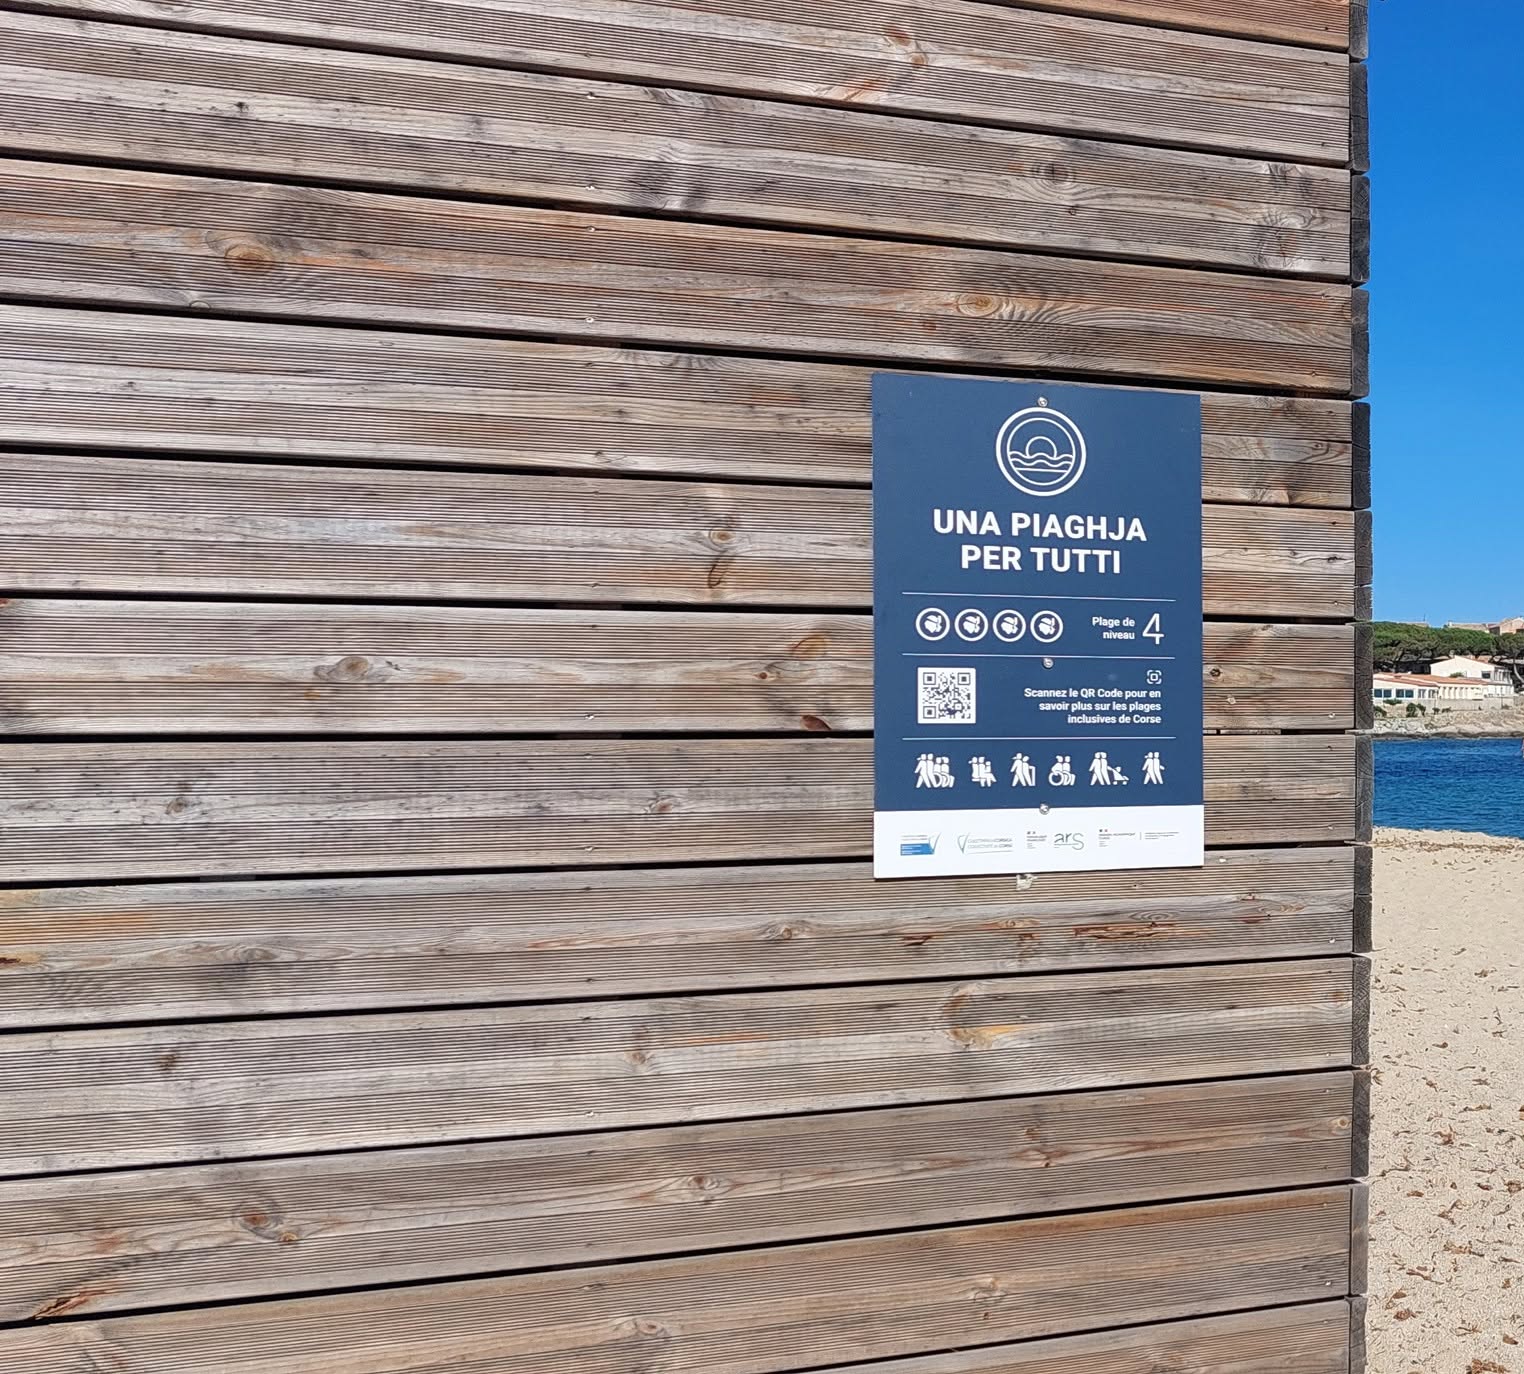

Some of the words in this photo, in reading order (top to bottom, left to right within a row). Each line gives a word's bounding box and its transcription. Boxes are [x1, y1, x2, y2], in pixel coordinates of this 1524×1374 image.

[933, 509, 1001, 536] UNA
[1011, 512, 1147, 541] PIAGHJA
[961, 545, 1022, 571] PER
[1030, 547, 1121, 574] TUTTI
[1092, 616, 1120, 628] Plage
[1122, 617, 1135, 627] de
[1142, 613, 1165, 645] 4
[1102, 631, 1135, 640] niveau
[1024, 688, 1067, 698] Scannez
[1069, 688, 1079, 698] le
[1080, 688, 1095, 698] QR
[1097, 688, 1123, 698] Code
[1125, 690, 1147, 700] pour
[1149, 690, 1161, 698] en
[1039, 701, 1069, 711] savoir
[1071, 701, 1093, 712] plus
[1094, 703, 1110, 711] sur
[1112, 701, 1127, 711] les
[1129, 702, 1162, 713] plages
[1067, 714, 1116, 723] inclusives
[1118, 714, 1131, 723] de
[1133, 714, 1161, 723] Corse
